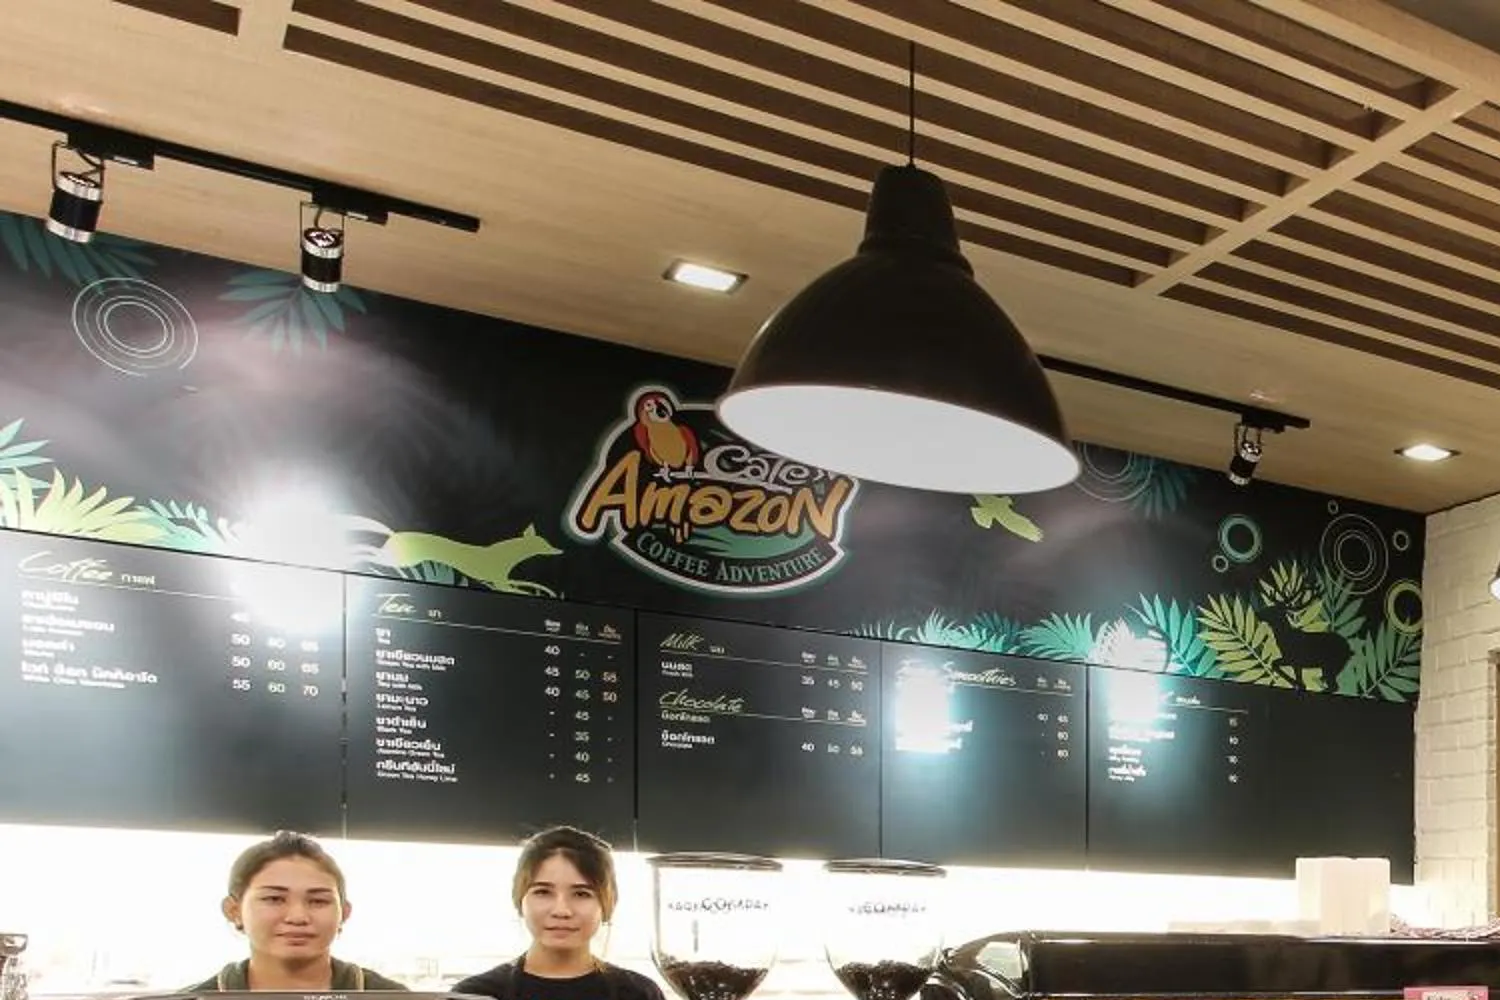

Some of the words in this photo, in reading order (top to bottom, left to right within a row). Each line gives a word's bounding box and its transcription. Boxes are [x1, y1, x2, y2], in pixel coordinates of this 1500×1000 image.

[18, 551, 113, 581] Coffee
[376, 593, 416, 614] Tea
[231, 634, 250, 645] 50
[660, 633, 704, 650] Milk
[544, 645, 560, 655] 40
[232, 656, 250, 668] 50
[233, 680, 250, 691] 55
[303, 685, 318, 697] 70
[544, 687, 560, 697] 40
[659, 688, 744, 713] Chocolate
[575, 773, 591, 783] 45
